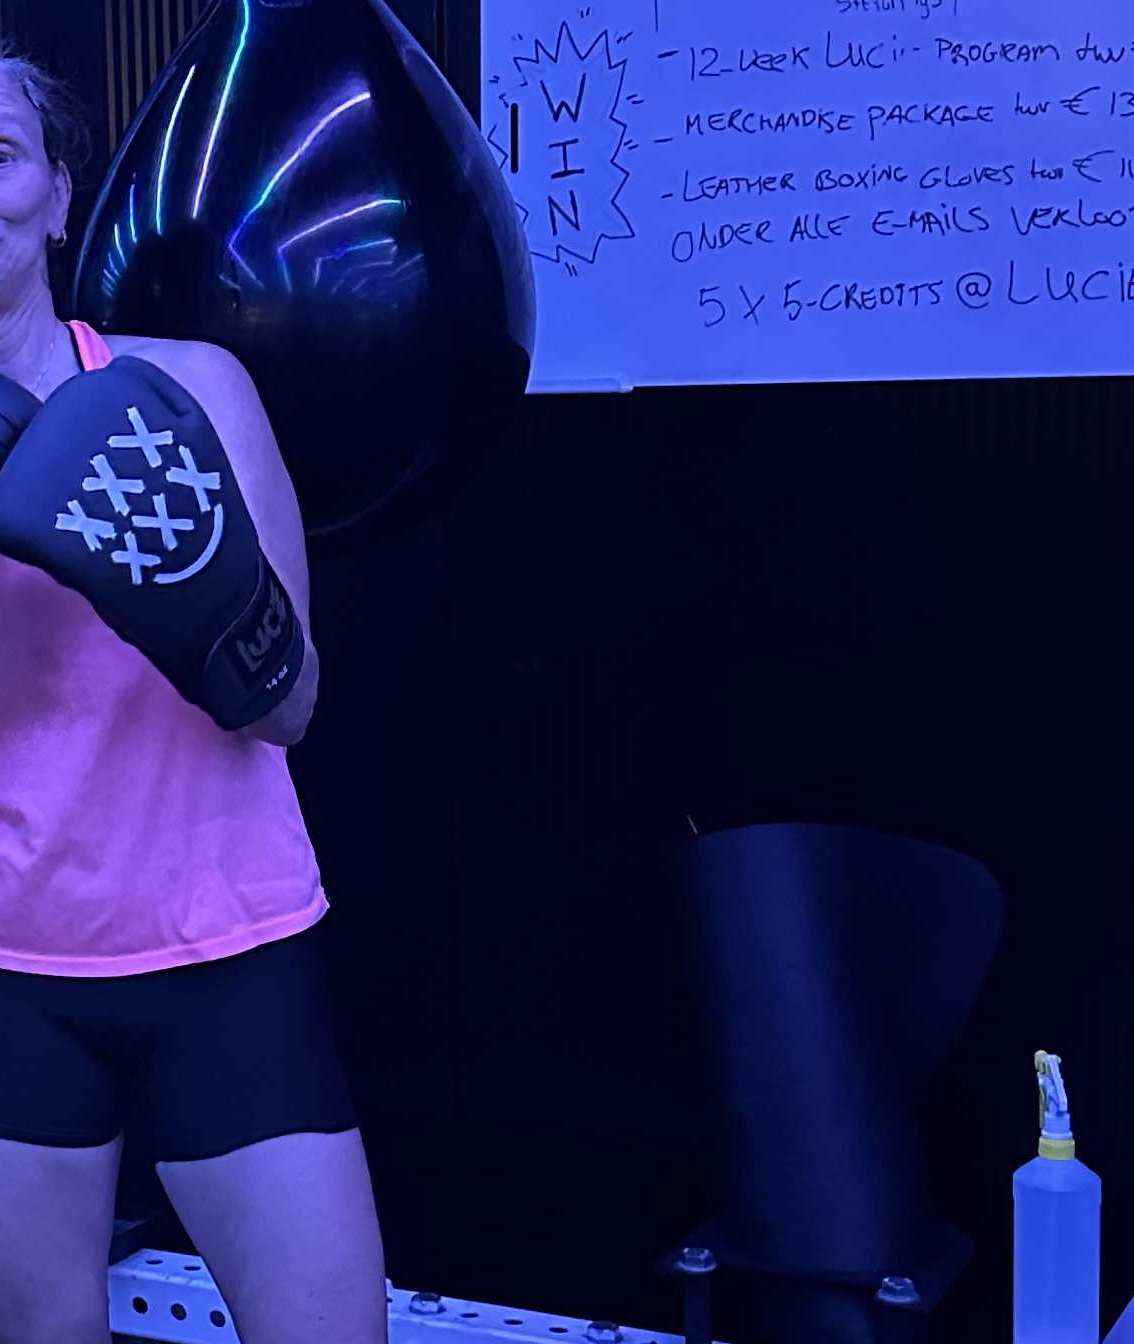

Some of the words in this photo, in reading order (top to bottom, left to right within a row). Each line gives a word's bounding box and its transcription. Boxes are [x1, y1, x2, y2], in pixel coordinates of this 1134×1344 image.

[935, 38, 1060, 67] PROGRAM
[868, 104, 994, 141] PACKAGE
[671, 220, 774, 263] ONDER
